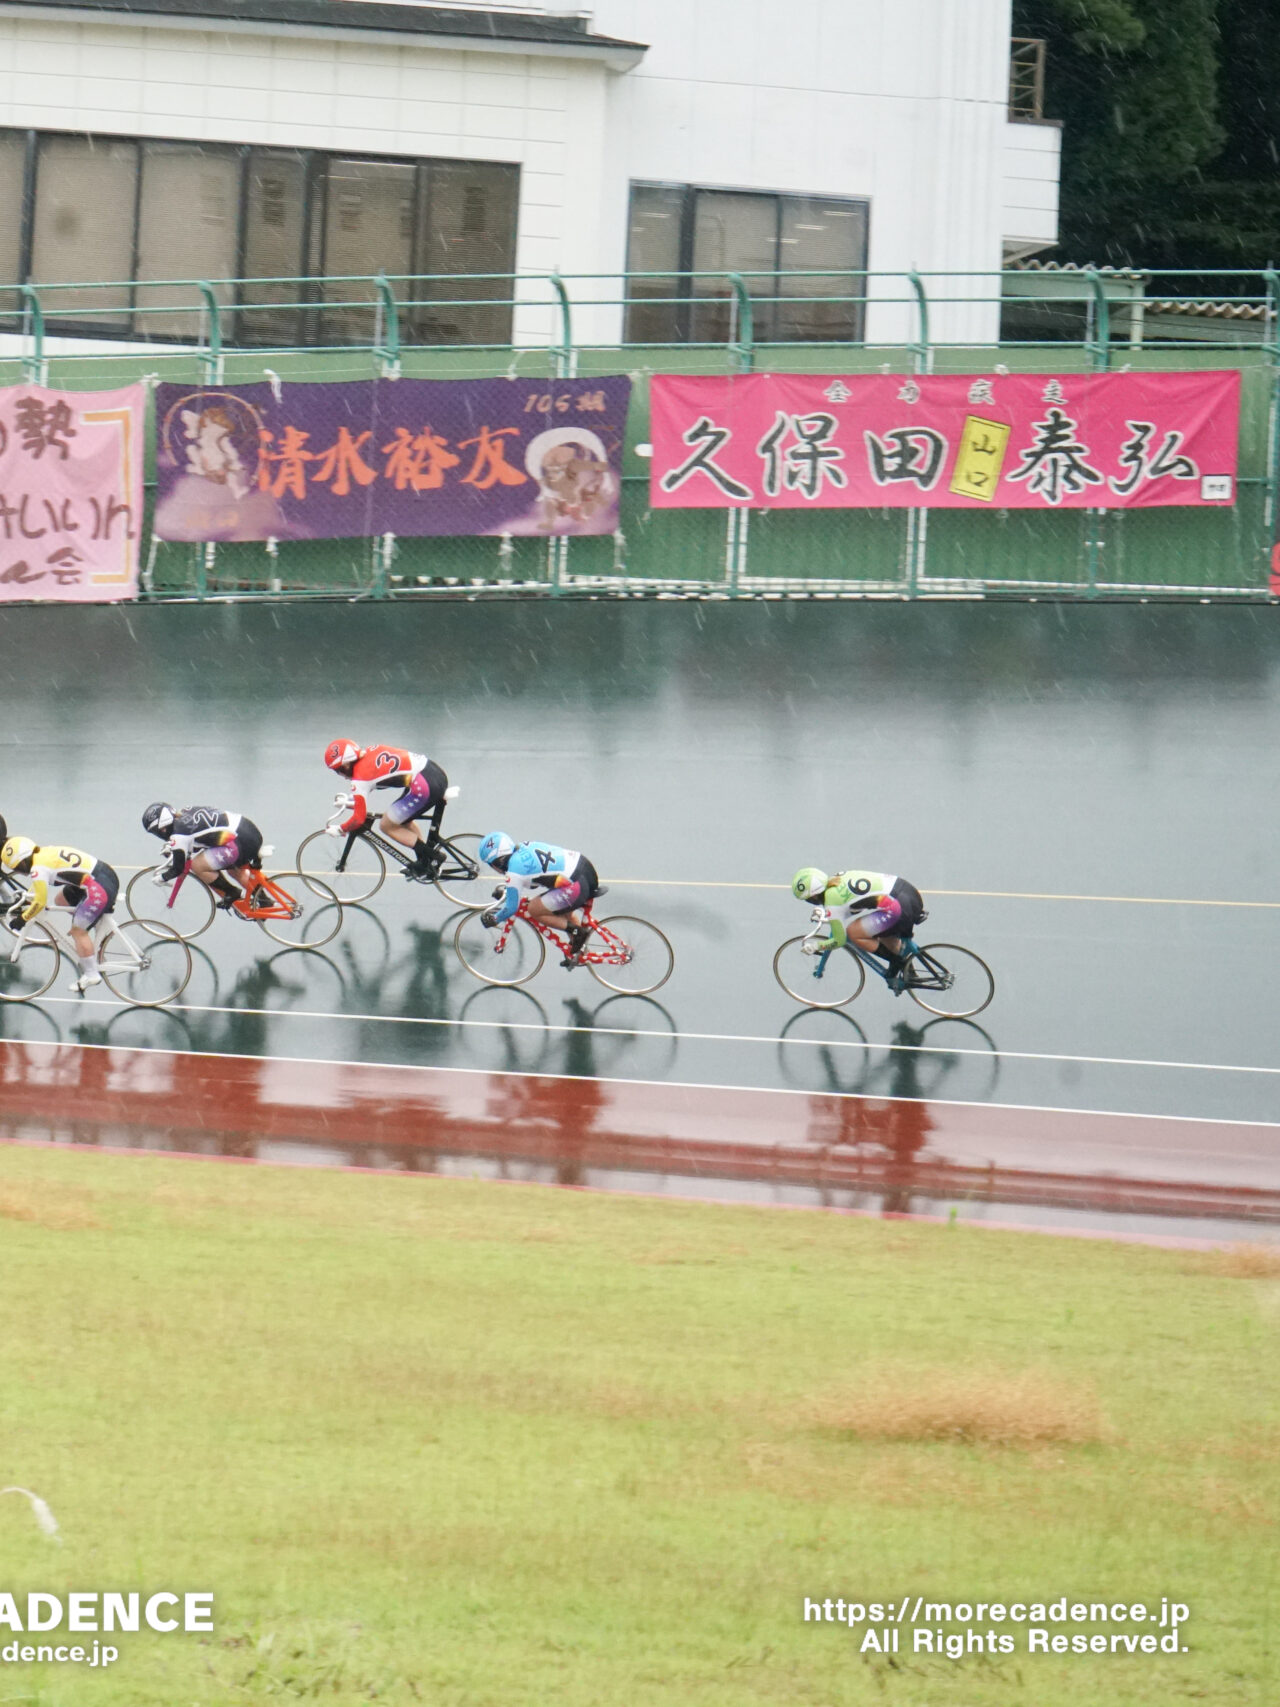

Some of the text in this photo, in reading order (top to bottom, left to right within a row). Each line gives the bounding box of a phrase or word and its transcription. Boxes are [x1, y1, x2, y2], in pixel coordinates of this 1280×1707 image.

[258, 425, 528, 500] 清水裕友
[965, 433, 998, 488] 山口
[1006, 408, 1202, 505] 泰弘
[330, 745, 340, 759] 3
[375, 750, 402, 775] 3
[192, 808, 219, 828] 2
[485, 838, 495, 849] 4
[59, 849, 83, 869] 5
[534, 848, 556, 874] 4
[796, 878, 806, 892] 6
[847, 877, 872, 896] 6
